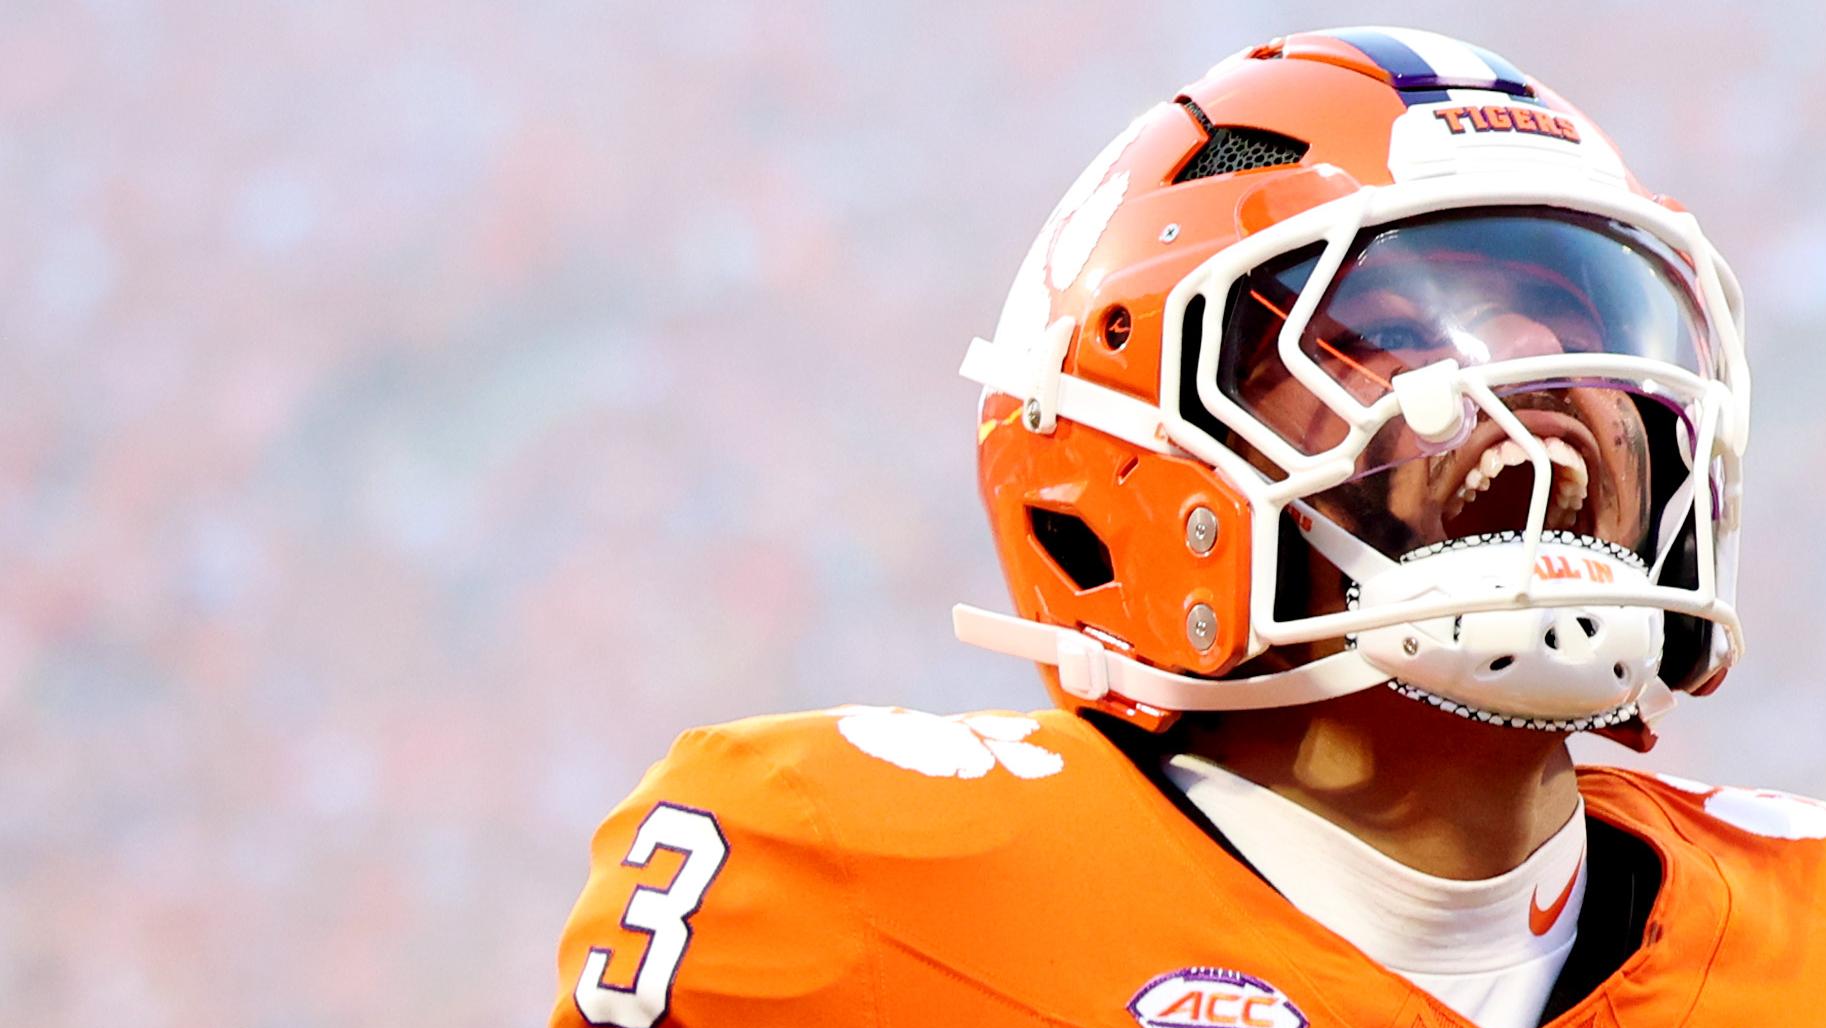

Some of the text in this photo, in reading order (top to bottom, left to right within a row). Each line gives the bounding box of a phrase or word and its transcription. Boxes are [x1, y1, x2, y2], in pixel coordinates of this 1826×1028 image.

[1433, 104, 1582, 145] TIGERS
[1582, 557, 1614, 584] IN
[1157, 990, 1280, 1028] ACC
